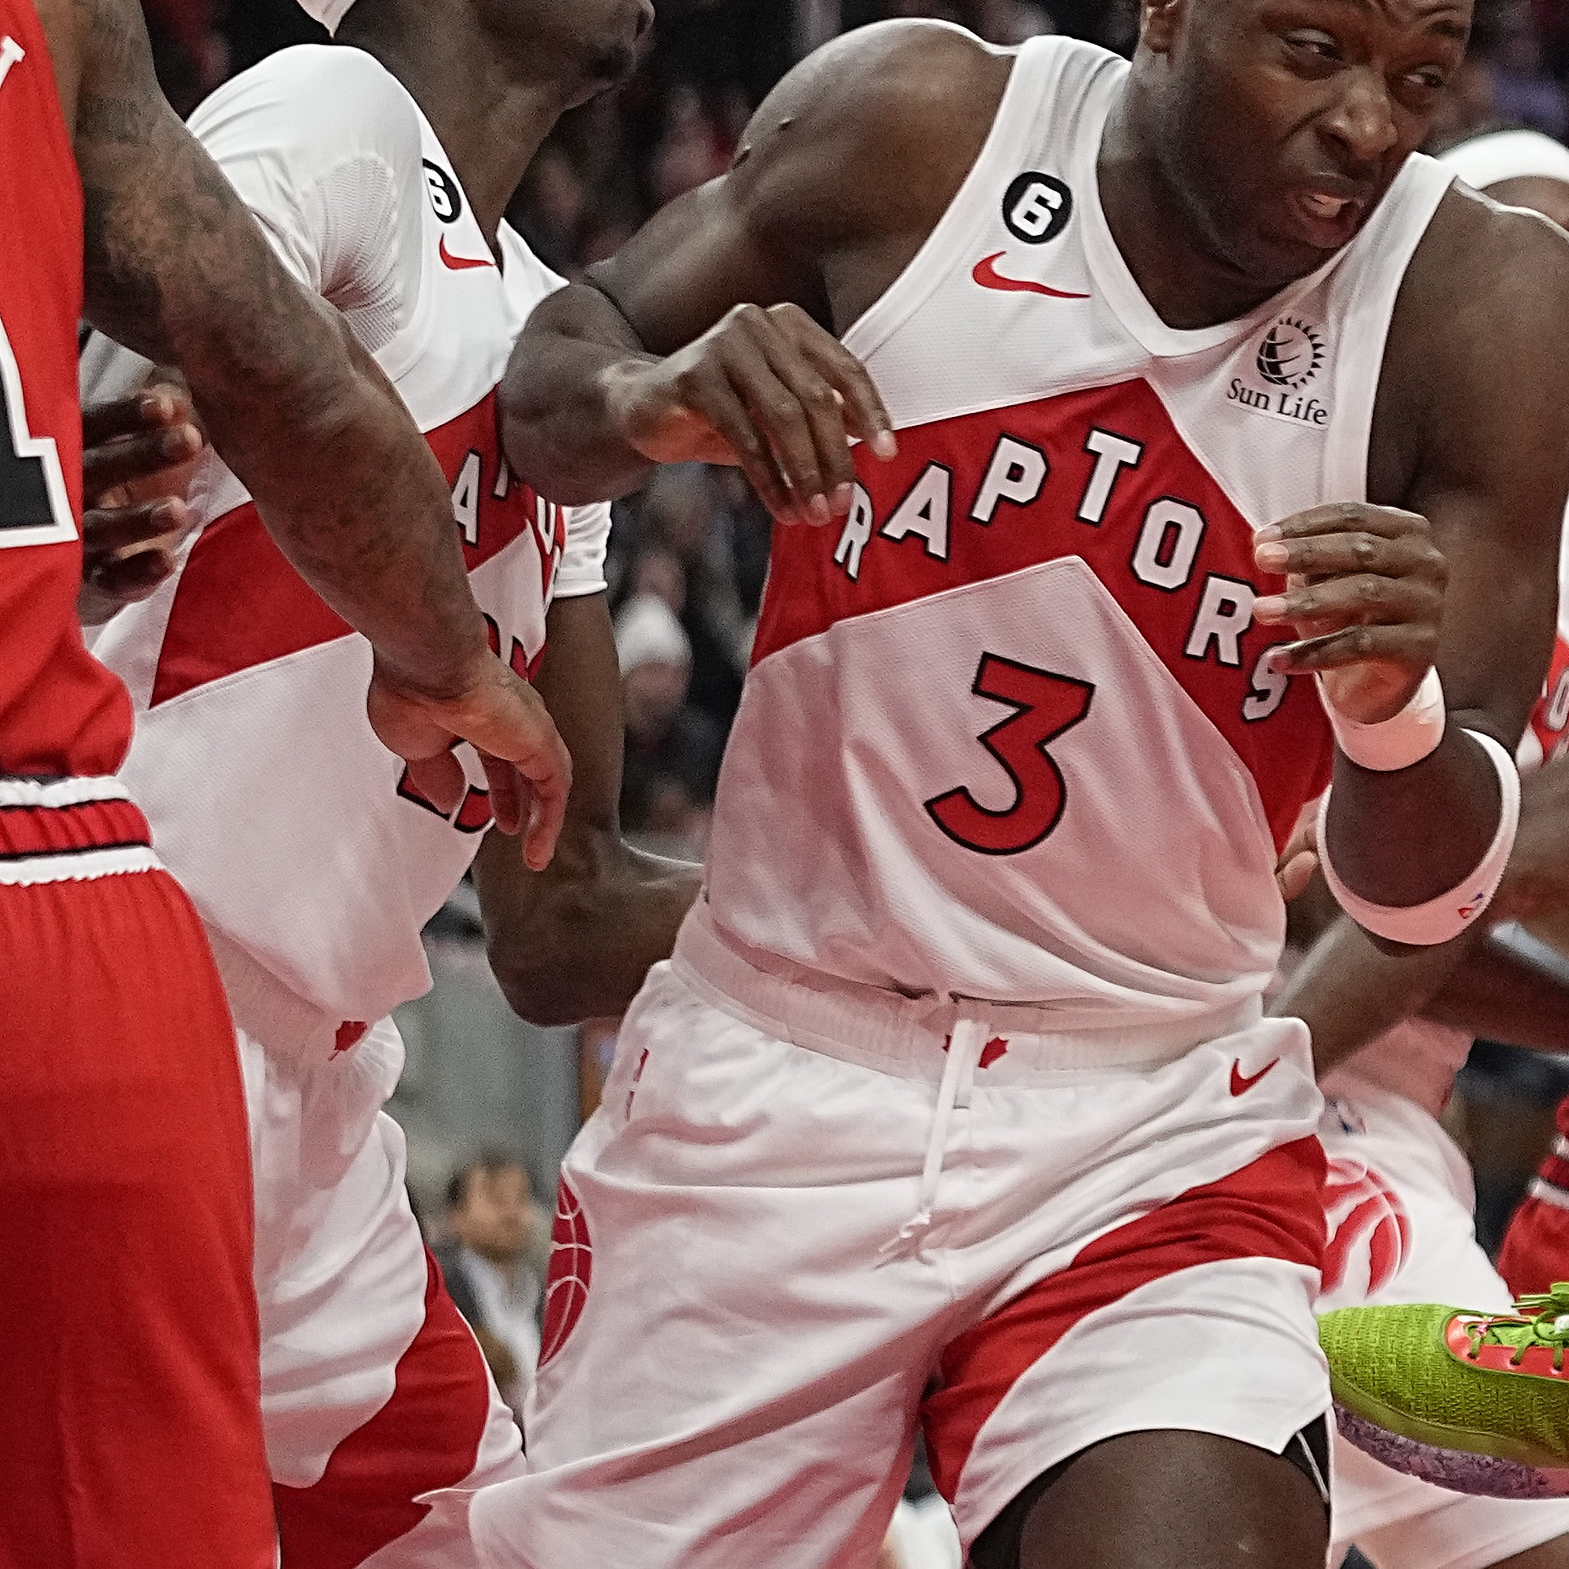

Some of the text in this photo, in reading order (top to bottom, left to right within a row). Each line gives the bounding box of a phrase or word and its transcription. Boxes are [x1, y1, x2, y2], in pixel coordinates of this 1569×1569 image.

[423, 167, 452, 217] 6
[1009, 182, 1063, 236] 6
[1227, 378, 1328, 425] Sun Life
[831, 427, 1293, 722] RAPTORS
[924, 650, 1095, 856] 3
